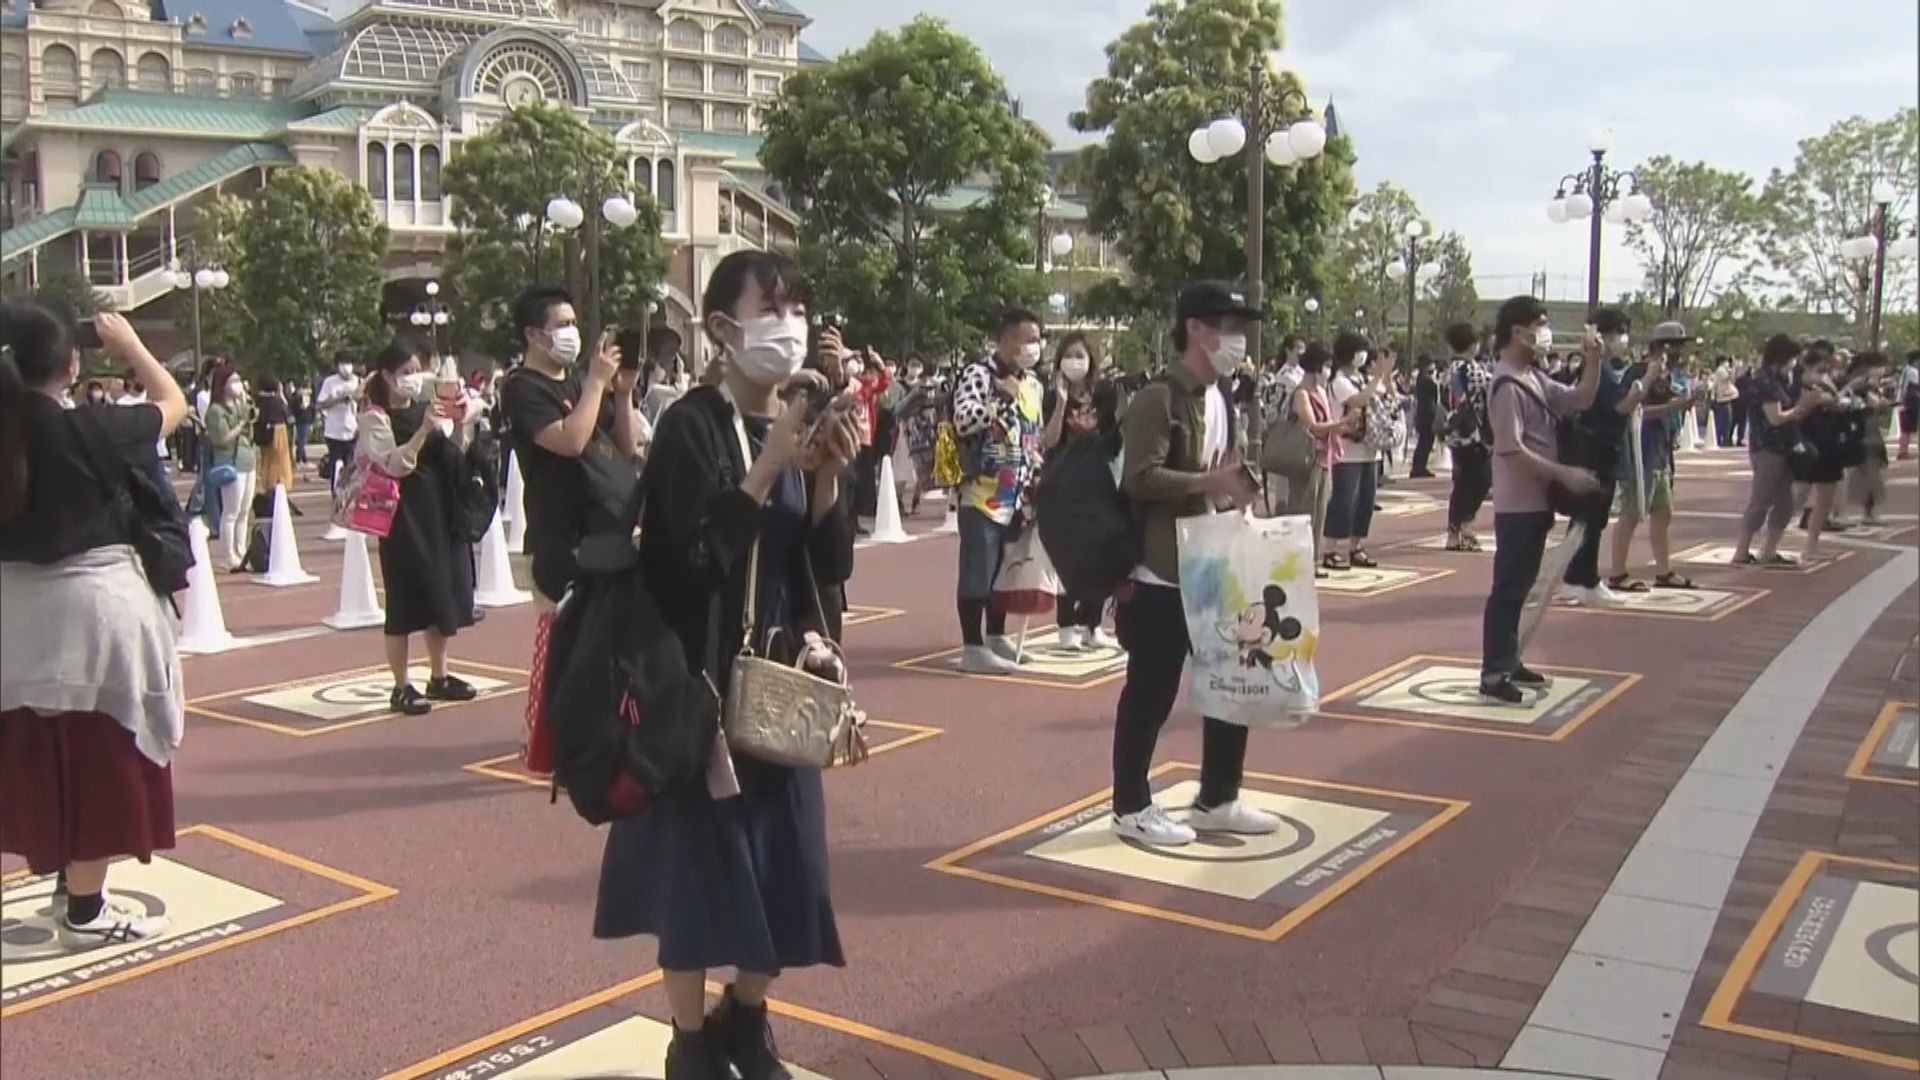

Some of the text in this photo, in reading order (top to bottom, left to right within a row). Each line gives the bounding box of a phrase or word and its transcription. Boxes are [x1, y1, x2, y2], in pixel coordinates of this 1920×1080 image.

[1, 923, 244, 1000] Please Stand Here
